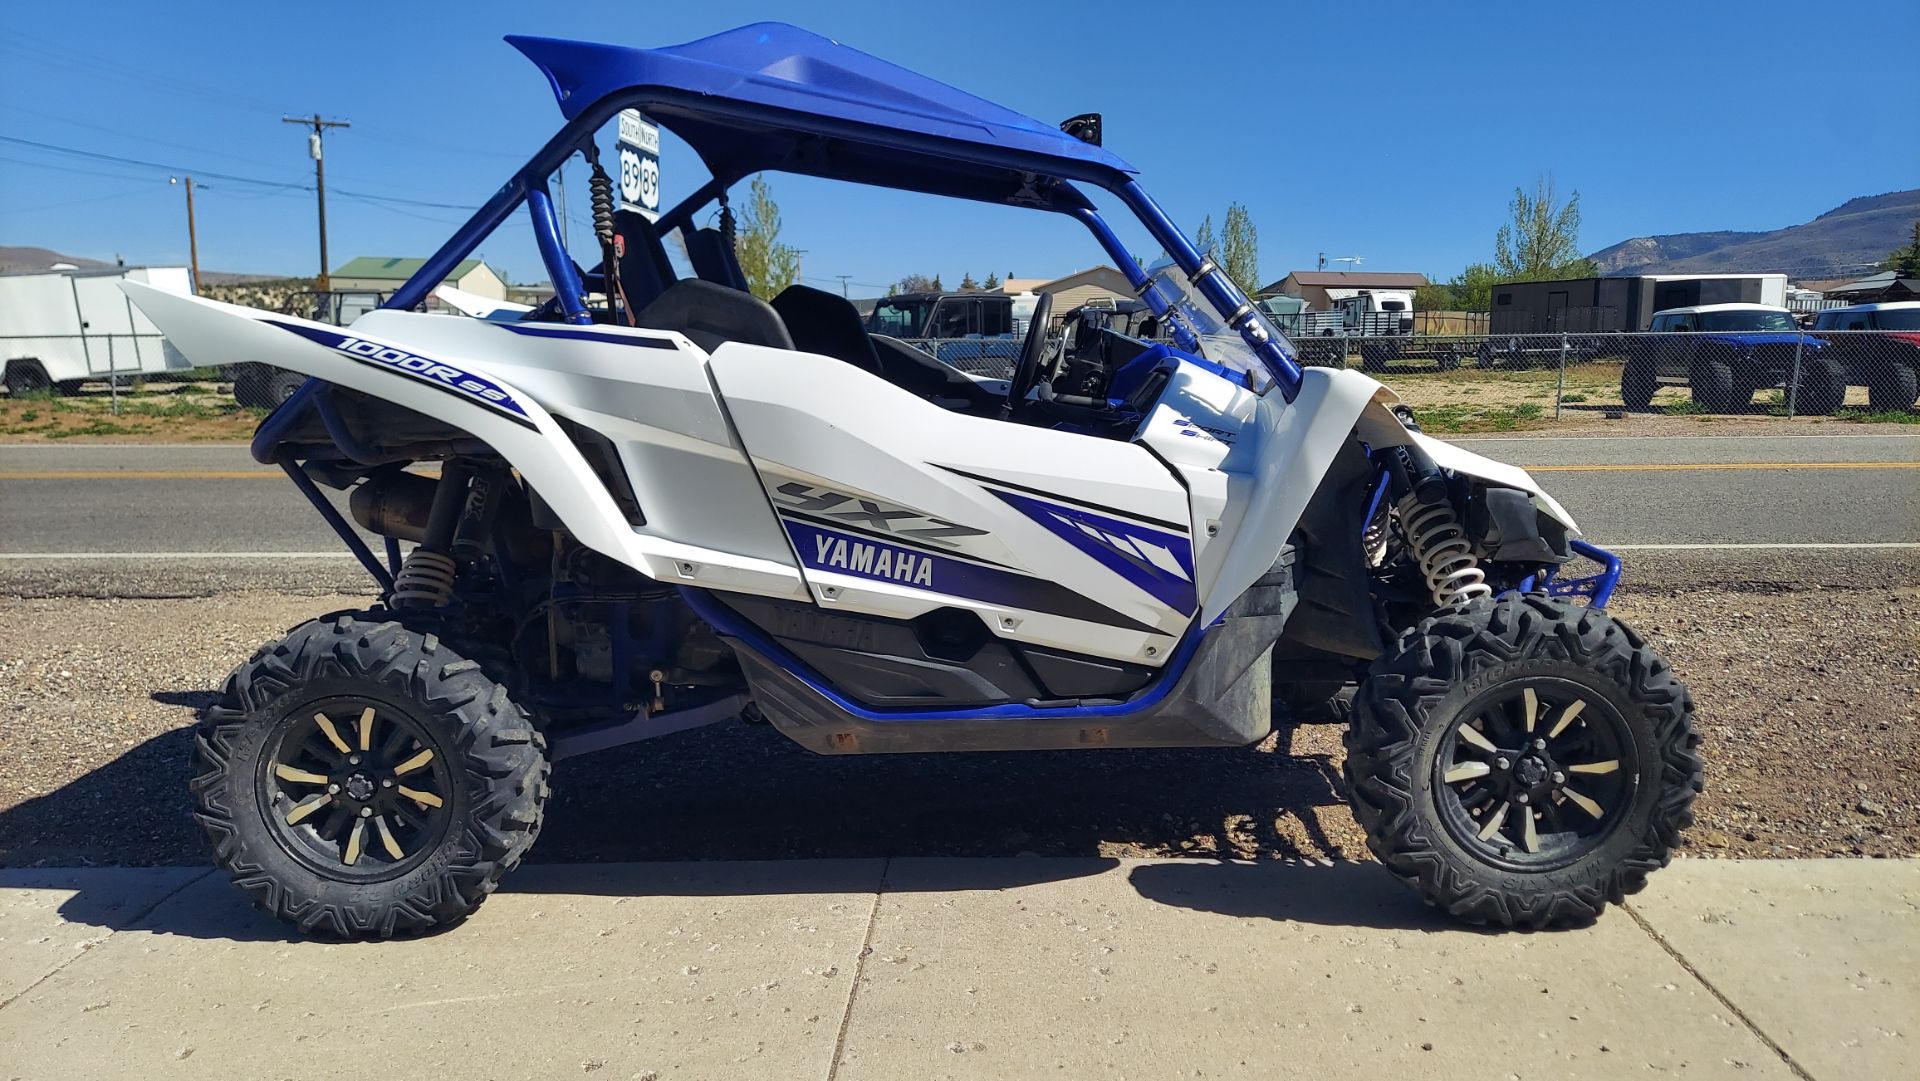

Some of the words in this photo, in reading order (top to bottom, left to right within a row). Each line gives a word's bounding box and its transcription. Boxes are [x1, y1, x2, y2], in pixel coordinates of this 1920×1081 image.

[621, 117, 640, 140] SOUTH
[641, 127, 658, 148] NORTH
[623, 159, 639, 190] 89
[642, 168, 658, 197] 89
[338, 338, 462, 384] 1000R
[1172, 419, 1236, 437] SPORT
[773, 482, 991, 546] YXZ
[815, 534, 932, 587] YAMAHA
